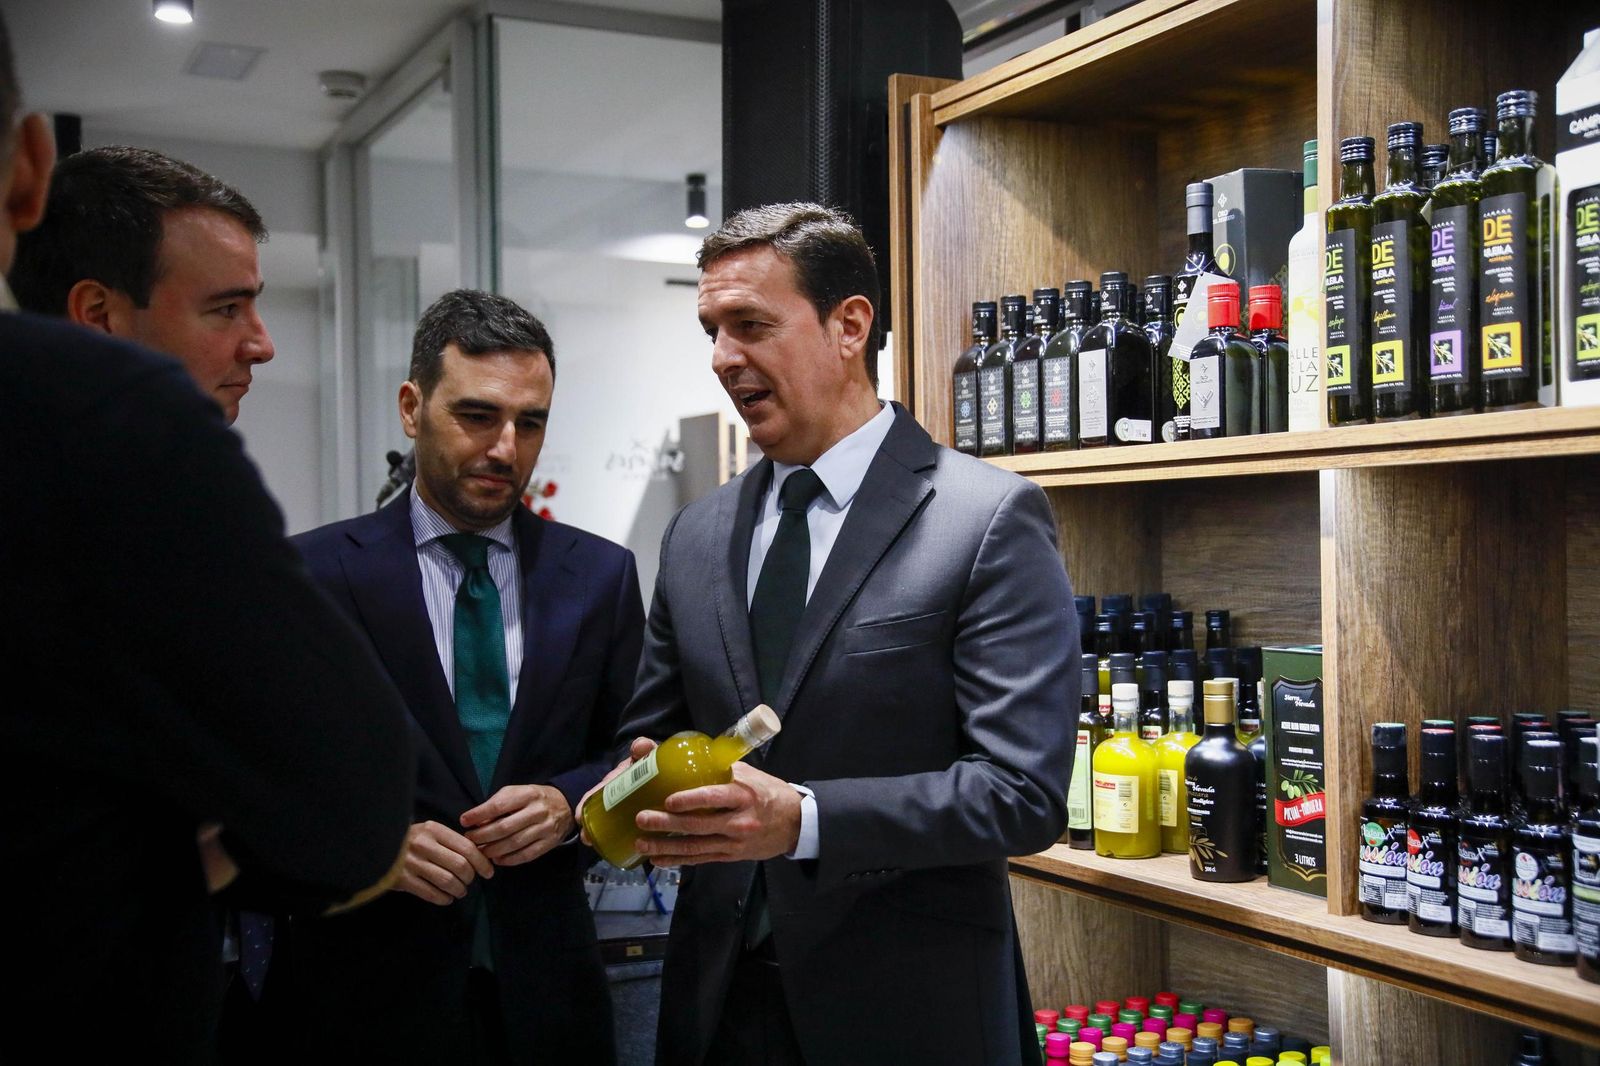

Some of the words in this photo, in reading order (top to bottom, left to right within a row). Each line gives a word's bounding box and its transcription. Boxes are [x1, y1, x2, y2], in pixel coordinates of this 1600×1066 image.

[1483, 215, 1513, 241] DE
[1576, 203, 1600, 229] DE
[1431, 227, 1455, 251] DE
[1372, 240, 1395, 264] DE
[1294, 853, 1299, 863] 3
[1299, 854, 1316, 867] LITROS
